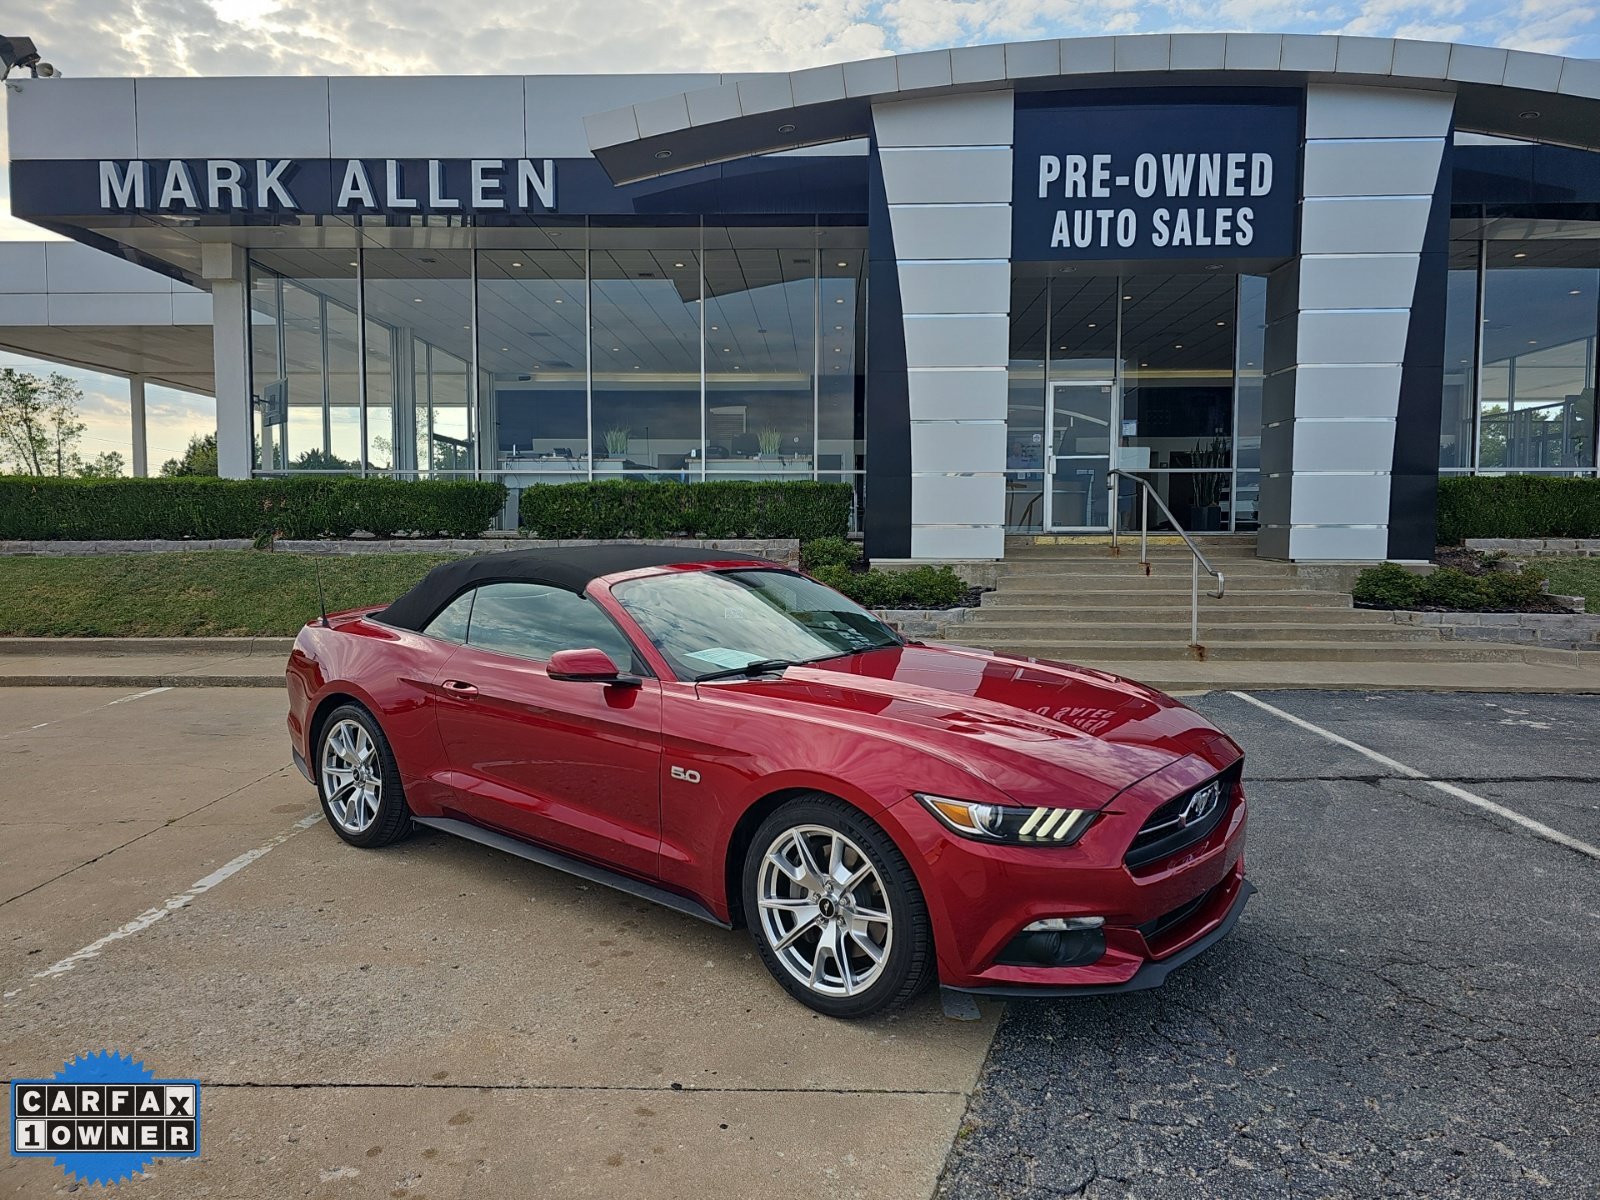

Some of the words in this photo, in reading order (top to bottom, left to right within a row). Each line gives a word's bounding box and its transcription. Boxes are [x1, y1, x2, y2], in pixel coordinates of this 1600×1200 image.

[99, 159, 298, 208] MARK
[337, 159, 555, 208] ALLEN
[1038, 152, 1273, 198] PRE-OWNED
[1050, 208, 1137, 248] AUTO
[1151, 206, 1254, 246] SALES
[670, 765, 701, 784] 5.0
